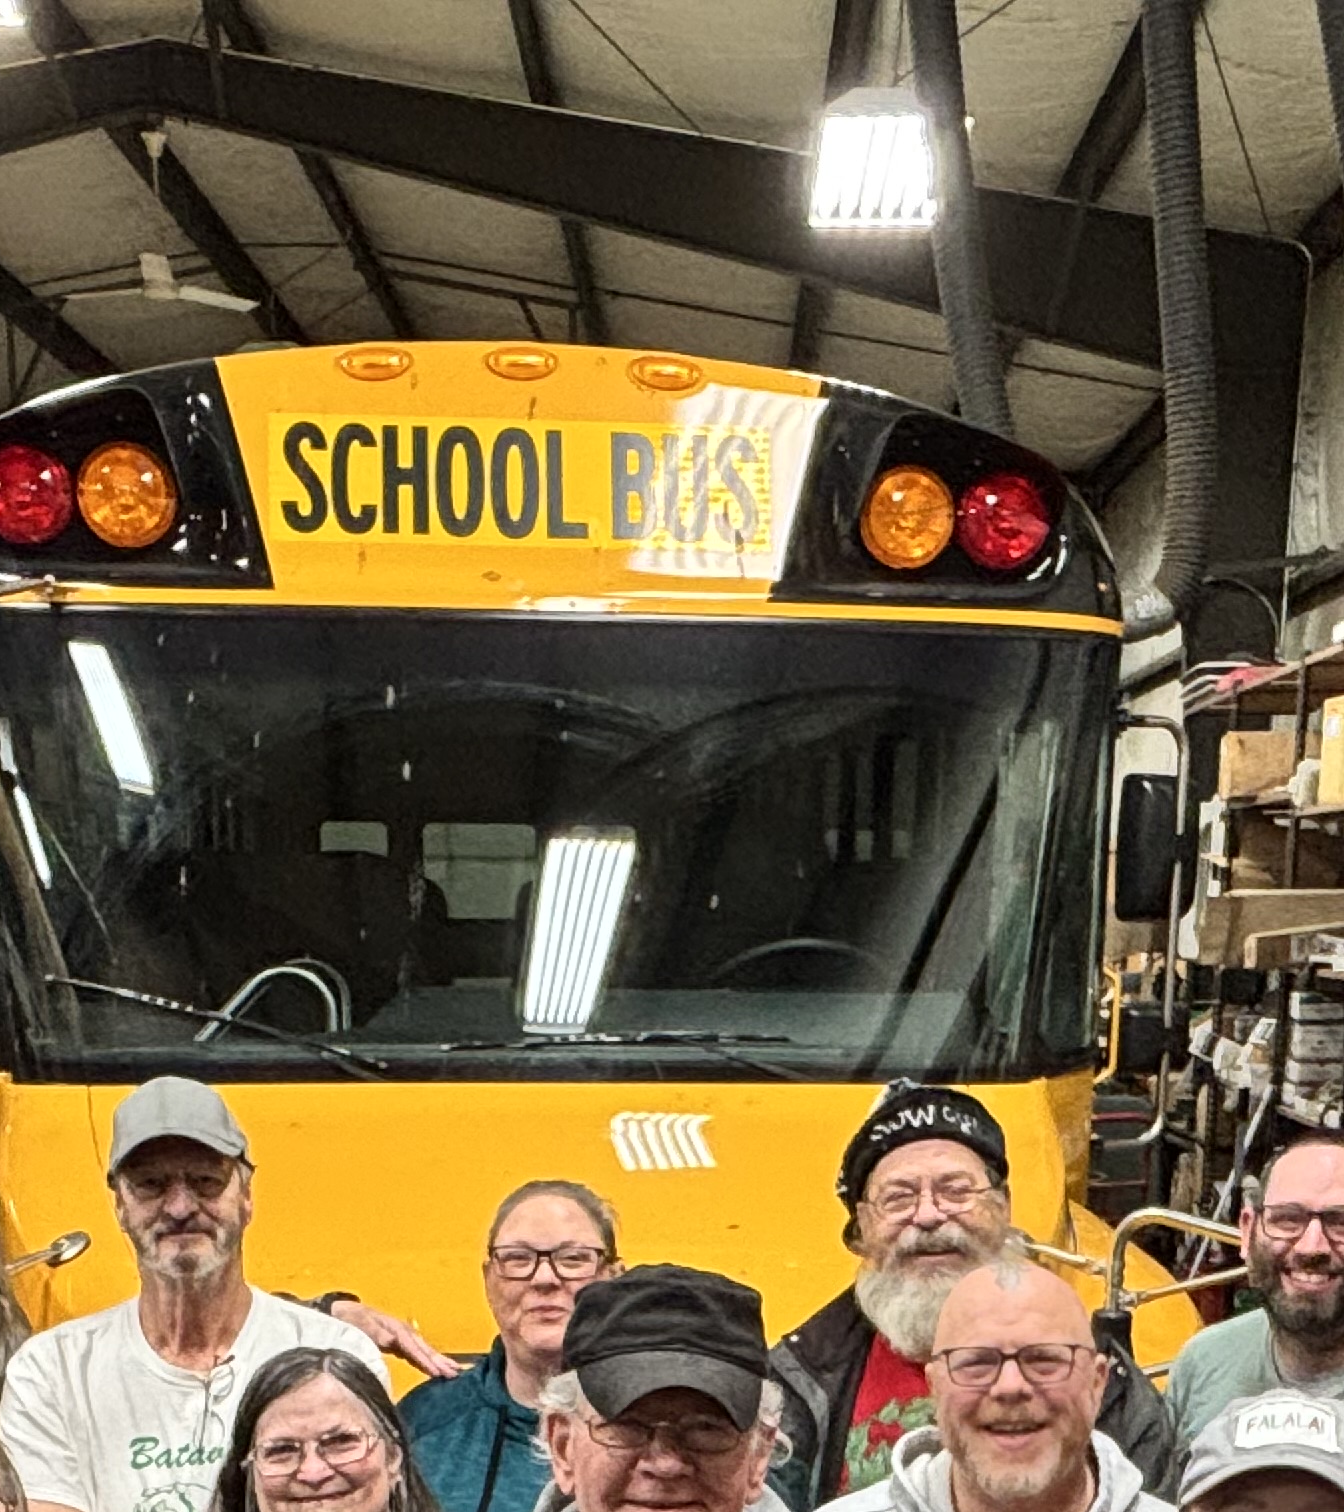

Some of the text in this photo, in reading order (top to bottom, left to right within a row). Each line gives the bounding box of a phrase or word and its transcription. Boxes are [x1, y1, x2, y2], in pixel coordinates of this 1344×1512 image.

[280, 421, 760, 545] SCHOOL BUS
[129, 1436, 225, 1470] Batav
